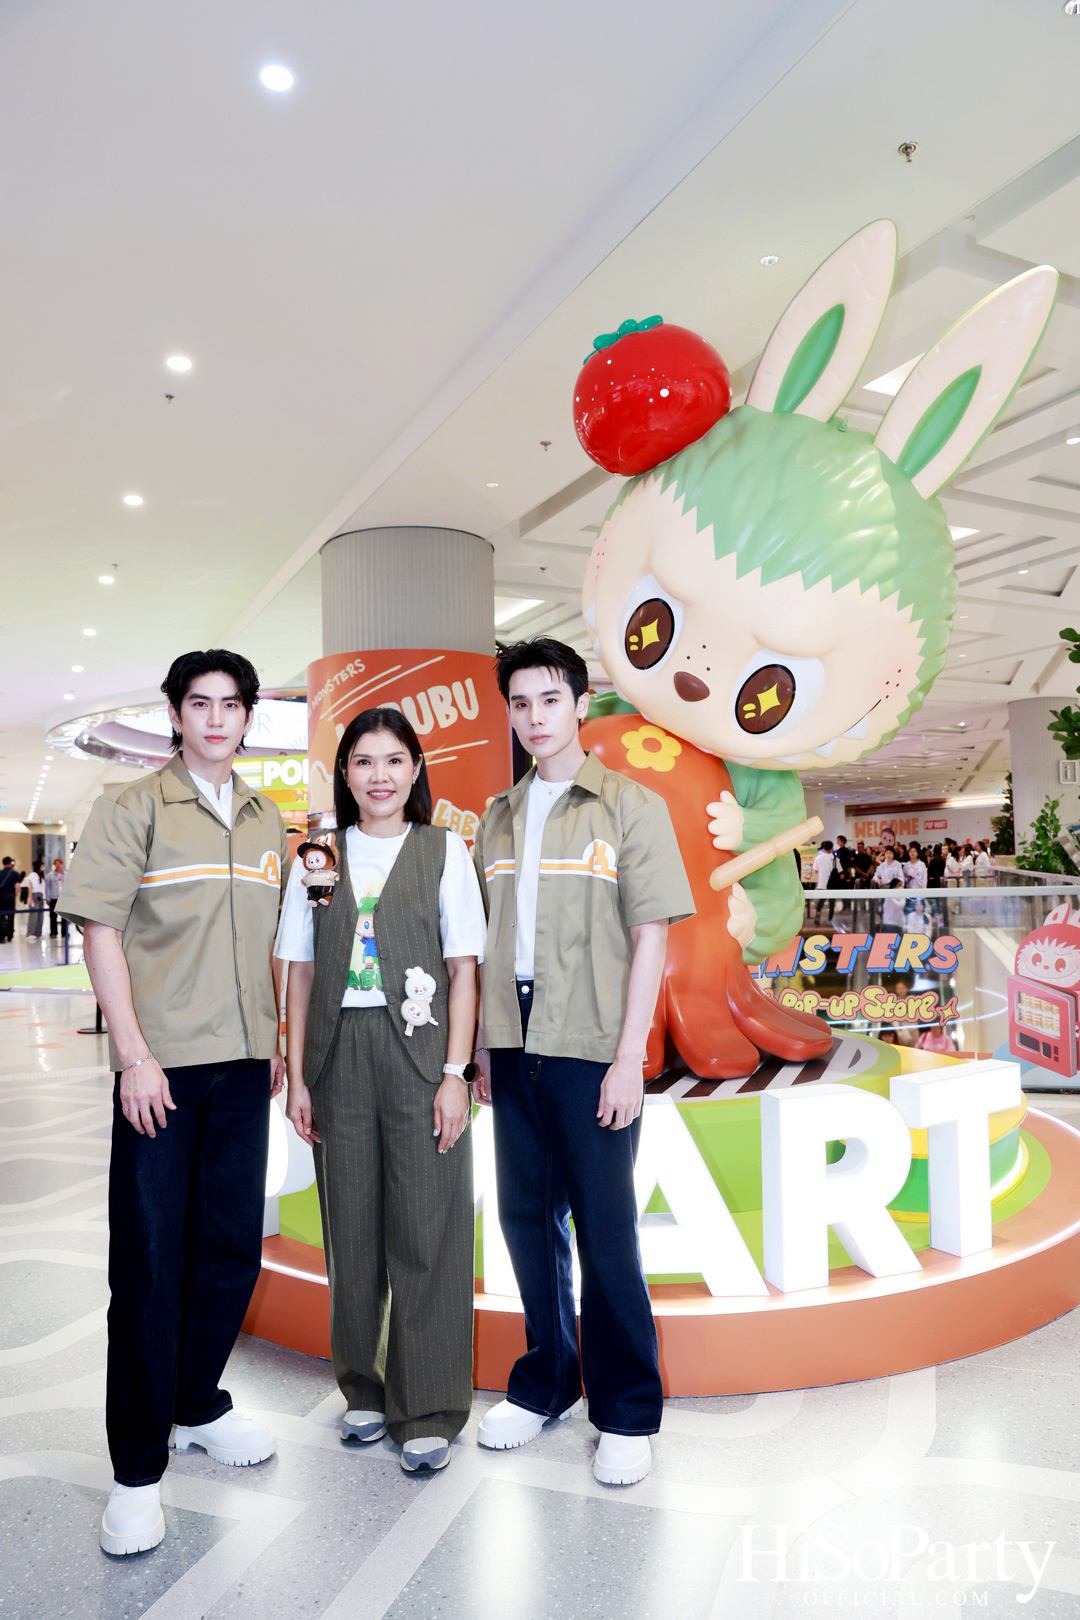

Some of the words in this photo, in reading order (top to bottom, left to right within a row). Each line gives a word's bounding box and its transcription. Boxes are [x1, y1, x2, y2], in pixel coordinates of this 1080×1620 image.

[311, 658, 366, 711] MONSTERS
[748, 933, 963, 978] NSTERS
[863, 986, 937, 1020] Store
